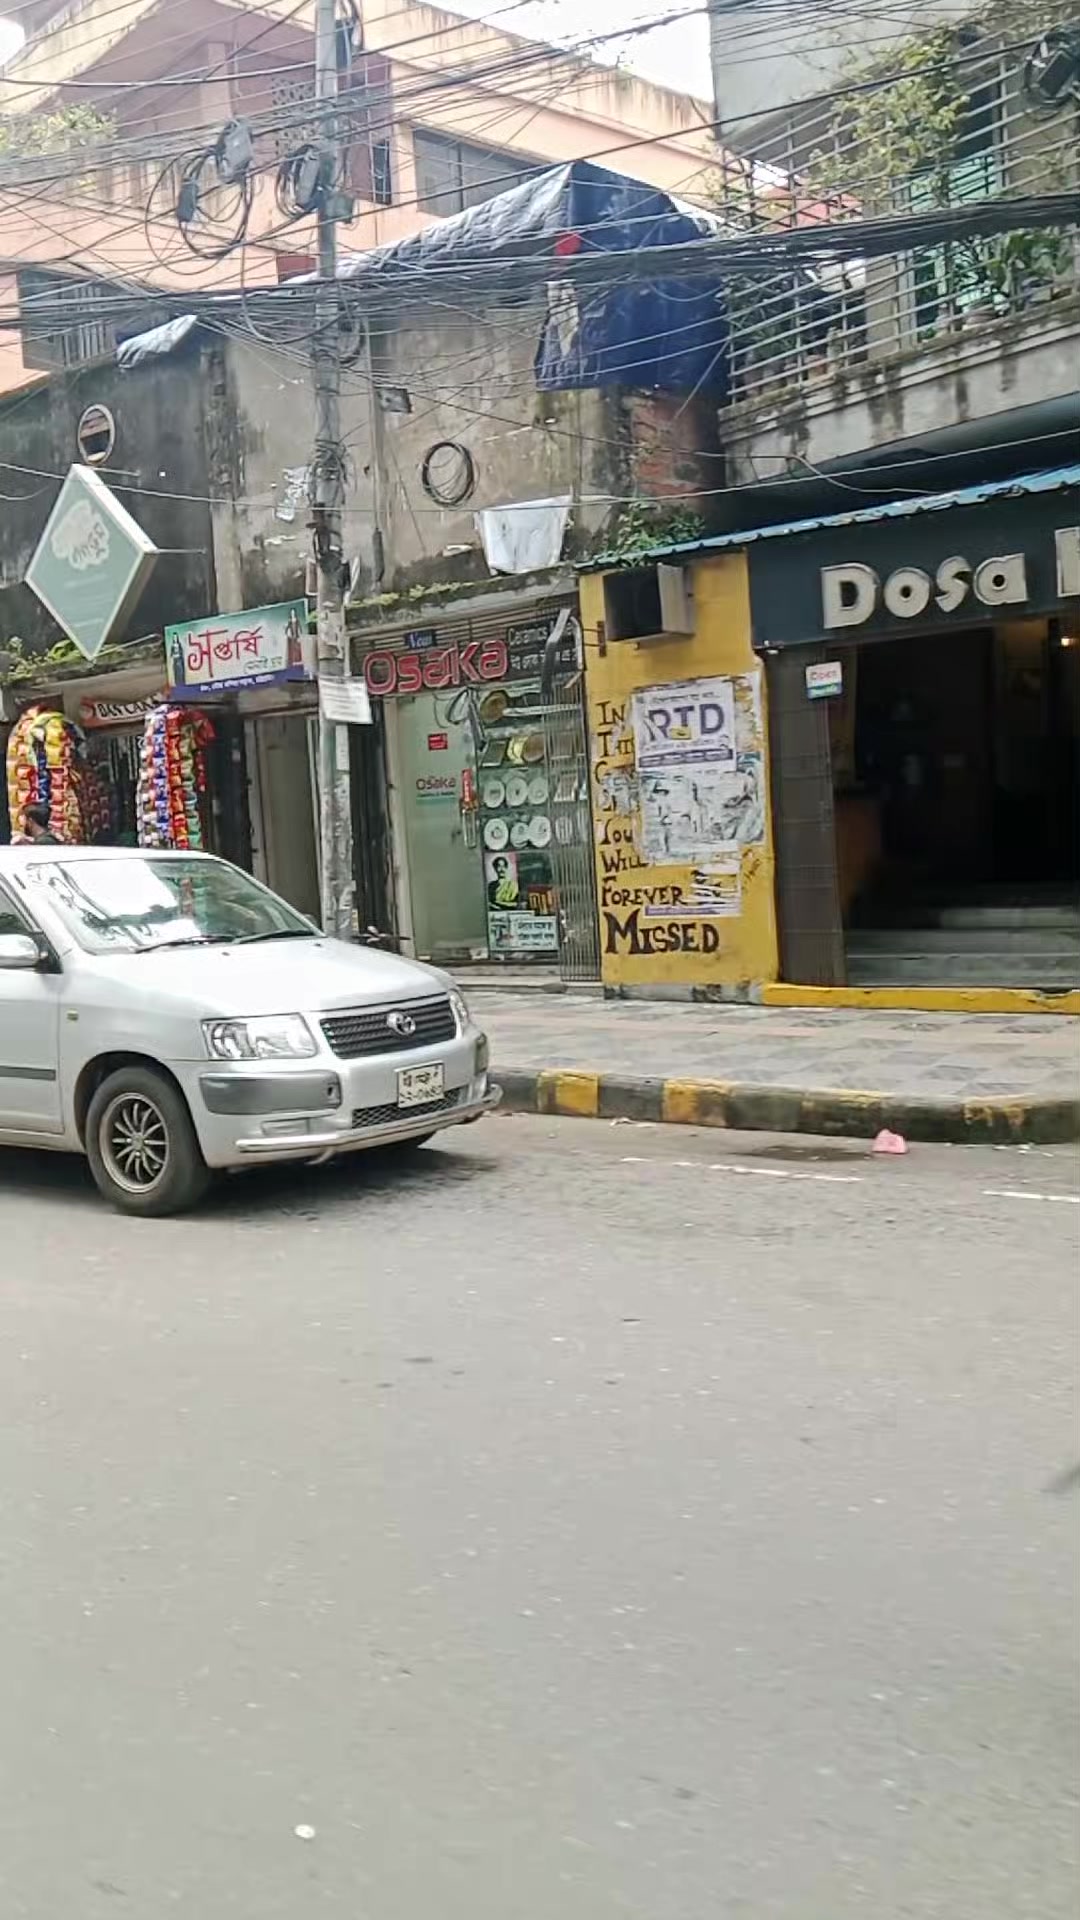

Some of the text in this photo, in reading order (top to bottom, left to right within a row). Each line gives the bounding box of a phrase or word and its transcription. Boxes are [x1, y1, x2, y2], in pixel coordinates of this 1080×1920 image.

[820, 553, 1029, 629] Dosa
[363, 639, 508, 695] Osaka
[603, 908, 720, 954] MISSED
